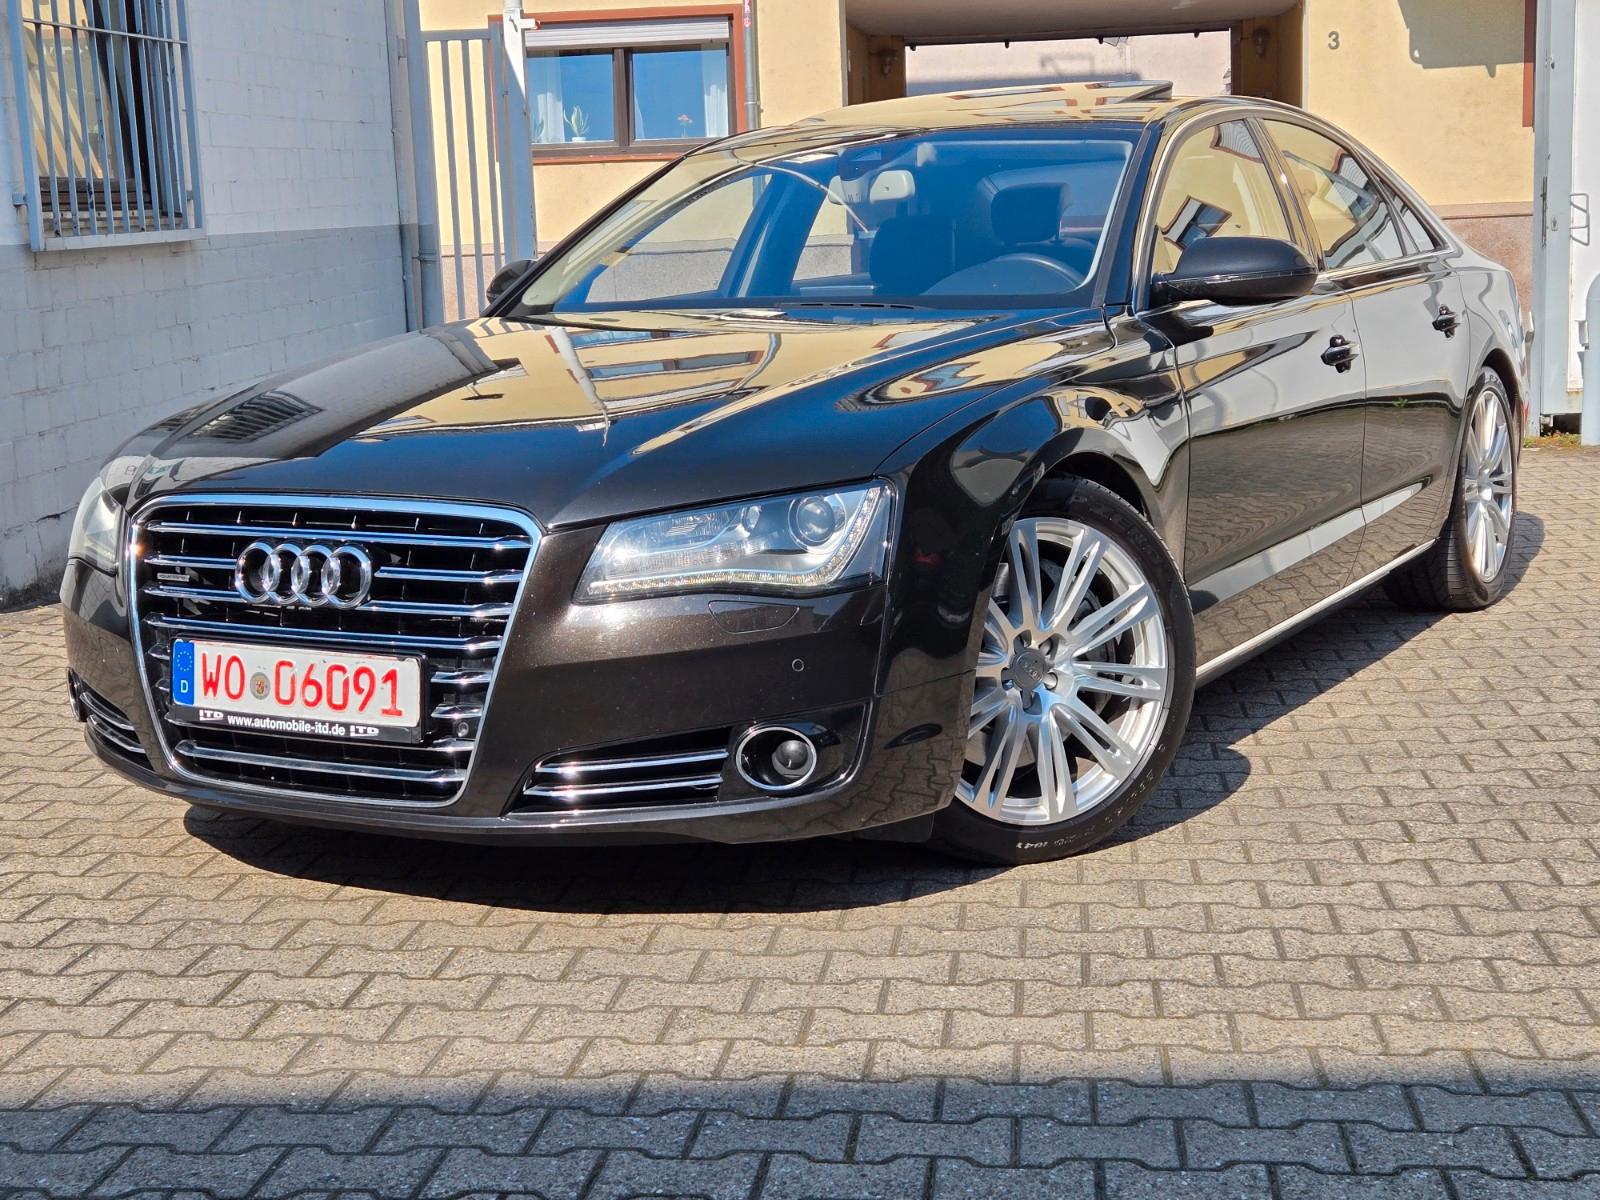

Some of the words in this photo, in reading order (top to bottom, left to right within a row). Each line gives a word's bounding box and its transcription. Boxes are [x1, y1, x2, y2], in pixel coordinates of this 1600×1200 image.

[1328, 31, 1340, 50] 3
[180, 679, 189, 693] D
[202, 653, 246, 701] WO
[274, 660, 404, 717] 06091
[227, 715, 346, 736] www.automobile-itd.de
